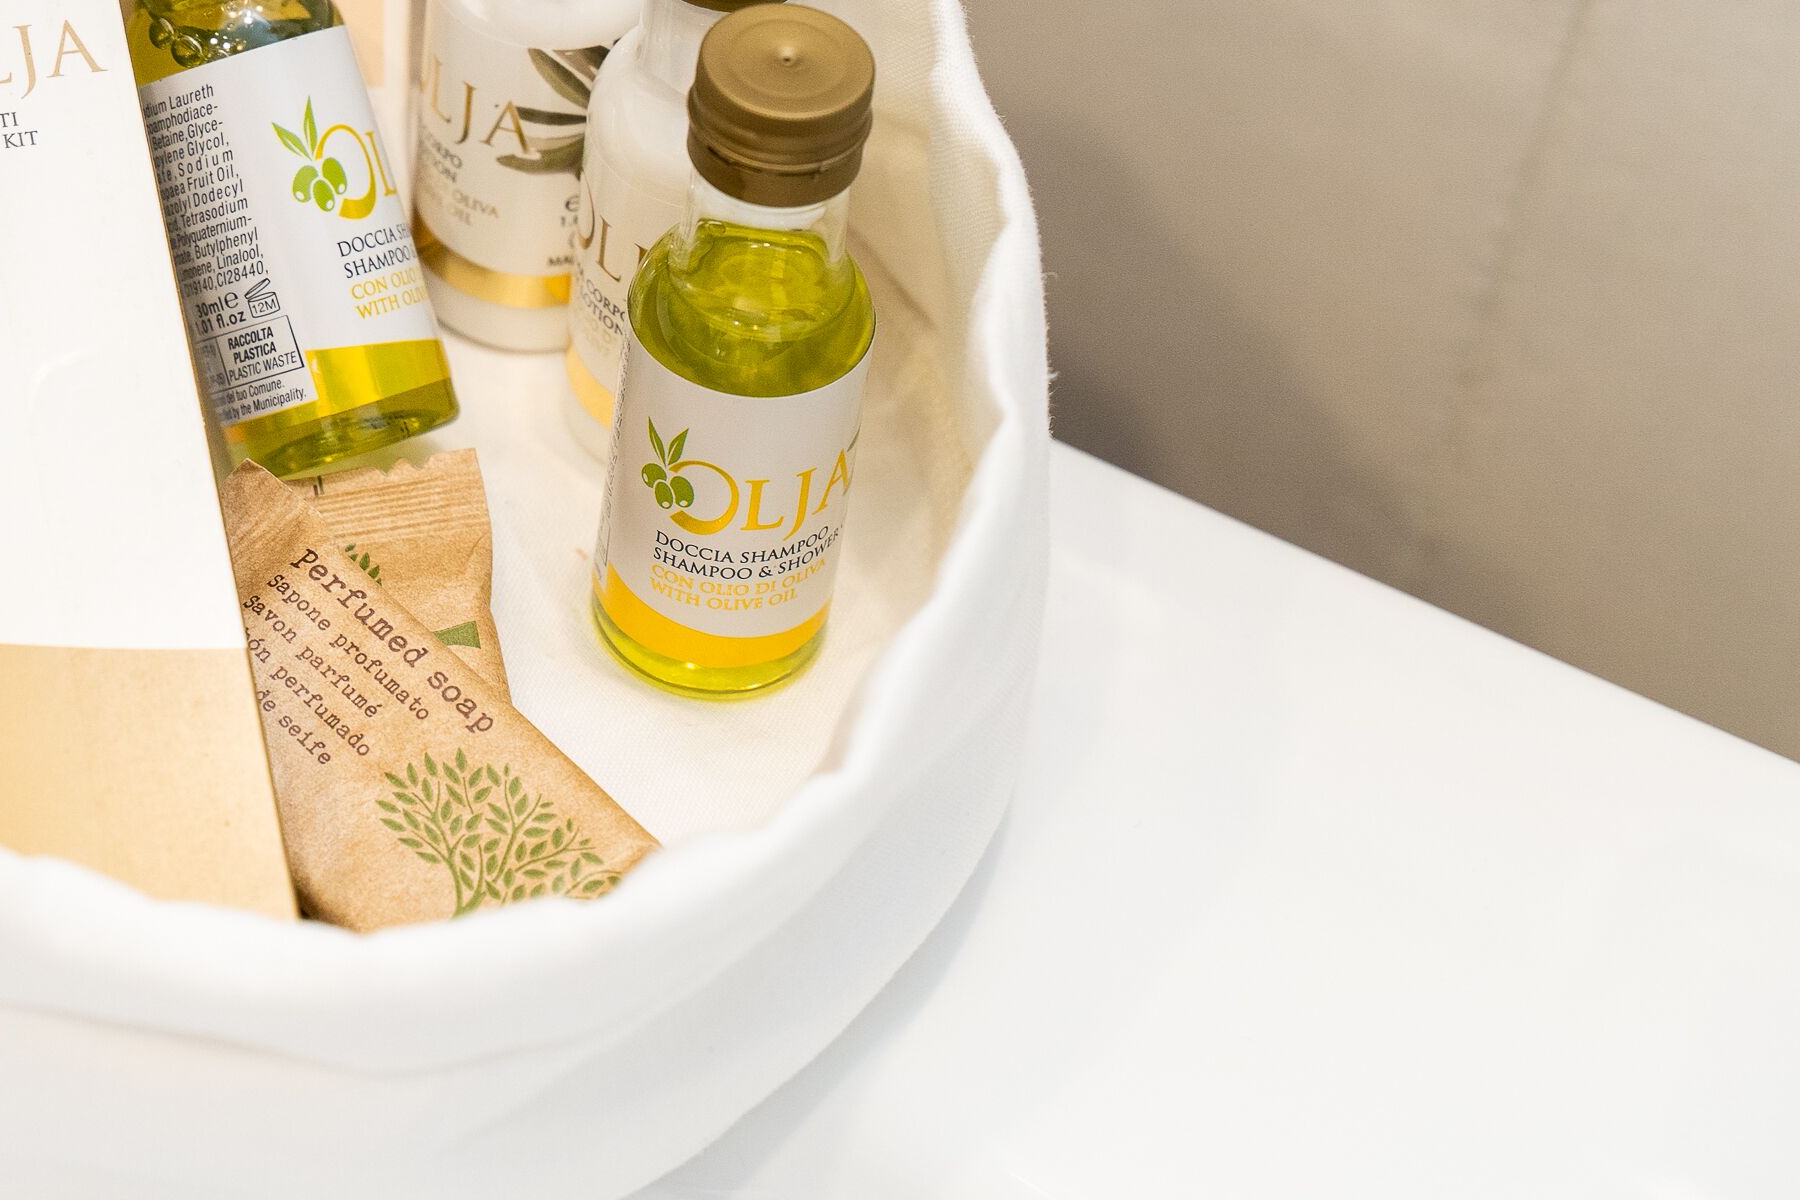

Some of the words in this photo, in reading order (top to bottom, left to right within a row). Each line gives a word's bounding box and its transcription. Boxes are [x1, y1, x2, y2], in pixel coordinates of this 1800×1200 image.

[144, 100, 168, 119] dium
[169, 84, 214, 110] Laureth
[422, 54, 540, 153] LJA
[3, 130, 38, 149] KIT
[187, 133, 229, 156] Glycol,
[178, 149, 234, 177] Sodium
[187, 172, 214, 191] Fruit
[217, 164, 239, 182] Oil,
[193, 179, 244, 207] Dodecyl
[181, 197, 248, 228] Tetrasodium
[194, 226, 258, 260] Butylphenyl
[216, 244, 264, 269] Linalool,
[337, 226, 397, 258] DOCCIA
[344, 245, 415, 279] SHAMPOO
[351, 275, 388, 300] CON
[196, 297, 224, 318] 30ml
[216, 311, 246, 329] fl.oz
[252, 299, 277, 314] 12M
[356, 294, 401, 320] WITH
[228, 326, 274, 350] RACCOLTA
[233, 341, 277, 365] PLASTICA
[228, 362, 261, 383] PLASTIC
[263, 350, 297, 372] WASTE
[241, 402, 252, 415] the
[253, 388, 307, 413] Municipality.
[248, 379, 285, 398] Comune.
[669, 447, 850, 541] OLJA
[654, 547, 753, 579] SHAMPOO
[759, 566, 773, 578] &
[778, 528, 839, 574] SHOWER
[655, 530, 734, 564] DOCCIA
[740, 526, 829, 564] SHAMPOO
[652, 564, 694, 589] CON
[700, 581, 749, 597] OLIO
[756, 580, 776, 595] DI
[782, 558, 826, 588] OLIVA
[650, 577, 700, 607] WITH
[706, 597, 763, 611] OLIVE
[768, 589, 798, 605] OIL
[267, 574, 331, 631] Sapone
[329, 634, 430, 720] profumato
[290, 548, 429, 668] Perfumed
[427, 671, 494, 733] soap
[243, 595, 297, 644] Savon
[295, 646, 383, 719] parfumé
[270, 666, 370, 757] perfumado
[279, 714, 332, 765] seife
